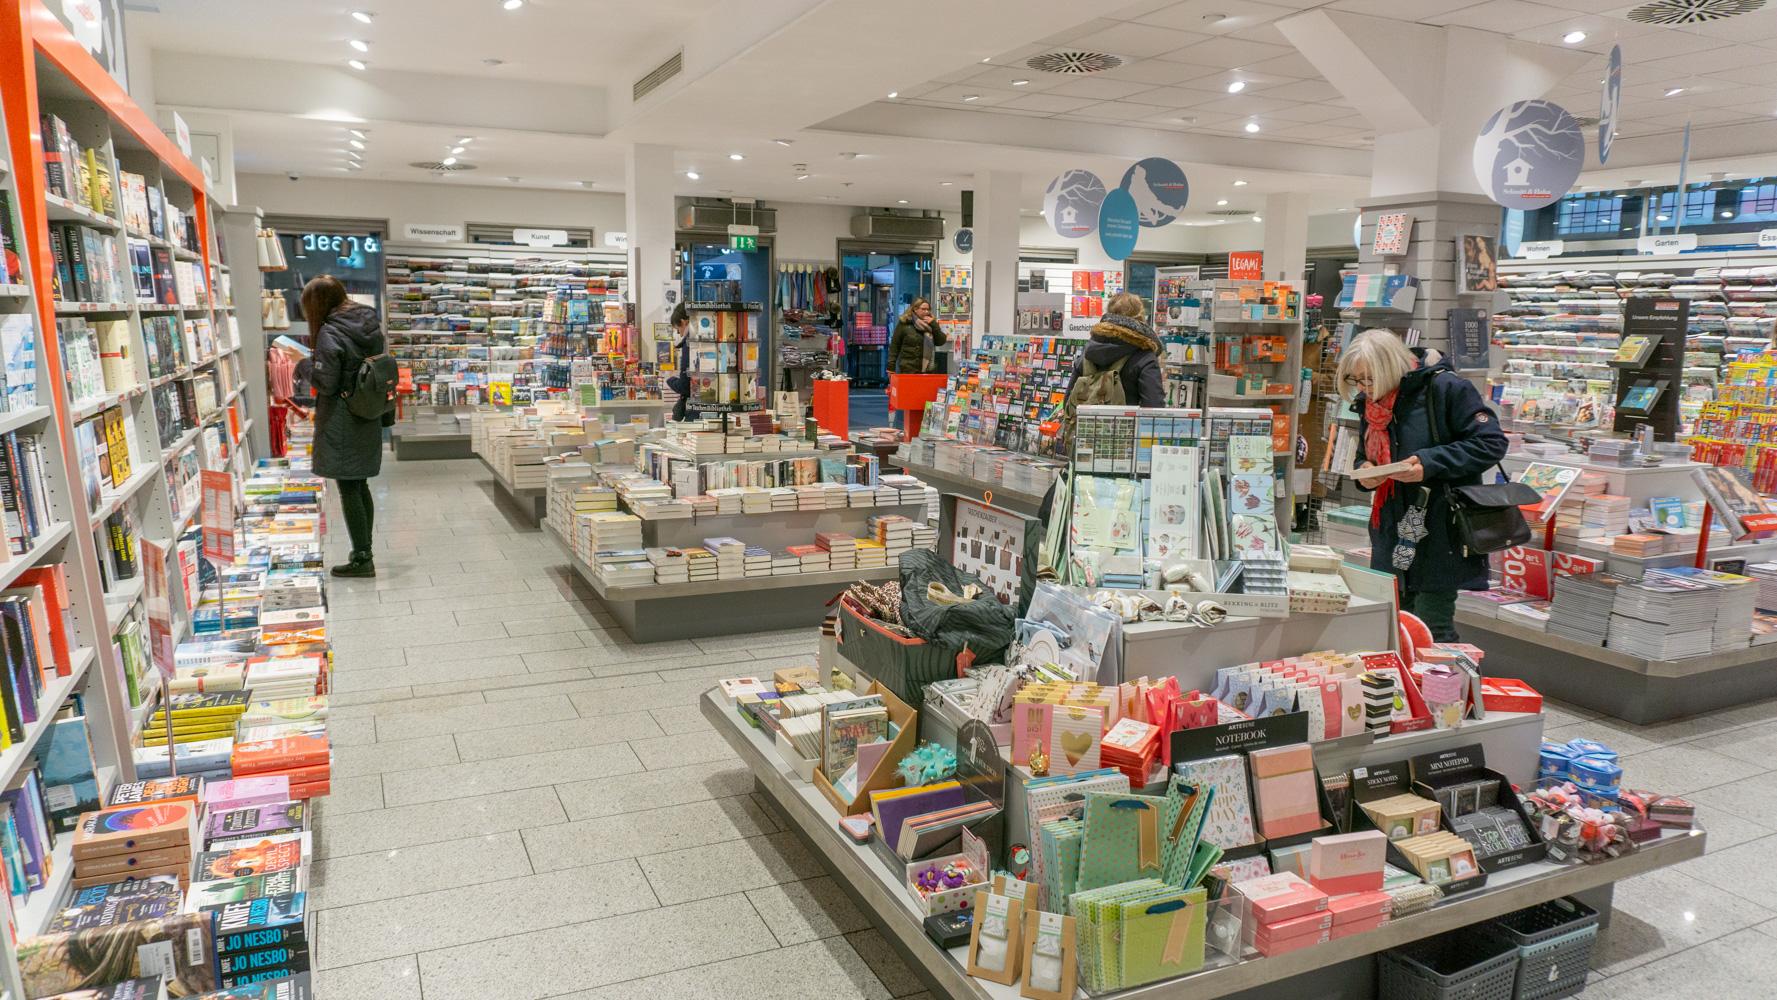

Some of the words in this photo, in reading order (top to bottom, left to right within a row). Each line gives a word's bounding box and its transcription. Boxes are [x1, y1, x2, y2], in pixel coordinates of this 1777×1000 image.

[409, 227, 457, 236] Wissenschaft
[1654, 239, 1679, 247] Garten
[1761, 233, 1777, 242] Ess
[1069, 323, 1093, 332] Geschich
[1464, 321, 1479, 329] 1000
[1525, 555, 1540, 563] art
[1572, 564, 1588, 574] art
[835, 719, 885, 739] TRAVEL
[1228, 721, 1255, 730] ARTEBENE
[1215, 729, 1267, 746] NOTEBOOK
[1443, 757, 1470, 768] NOTEPAD
[1367, 776, 1383, 785] STICKY
[115, 782, 133, 805] PETER
[129, 780, 146, 802] JAMES
[264, 847, 278, 872] DEVIL
[277, 842, 292, 873] ASPECT
[1497, 853, 1523, 864] ARTEBENE
[220, 900, 252, 930] KNIFE
[226, 935, 241, 951] JO
[244, 928, 282, 948] NESBO
[232, 955, 247, 972] JO
[249, 948, 287, 968] NESBO
